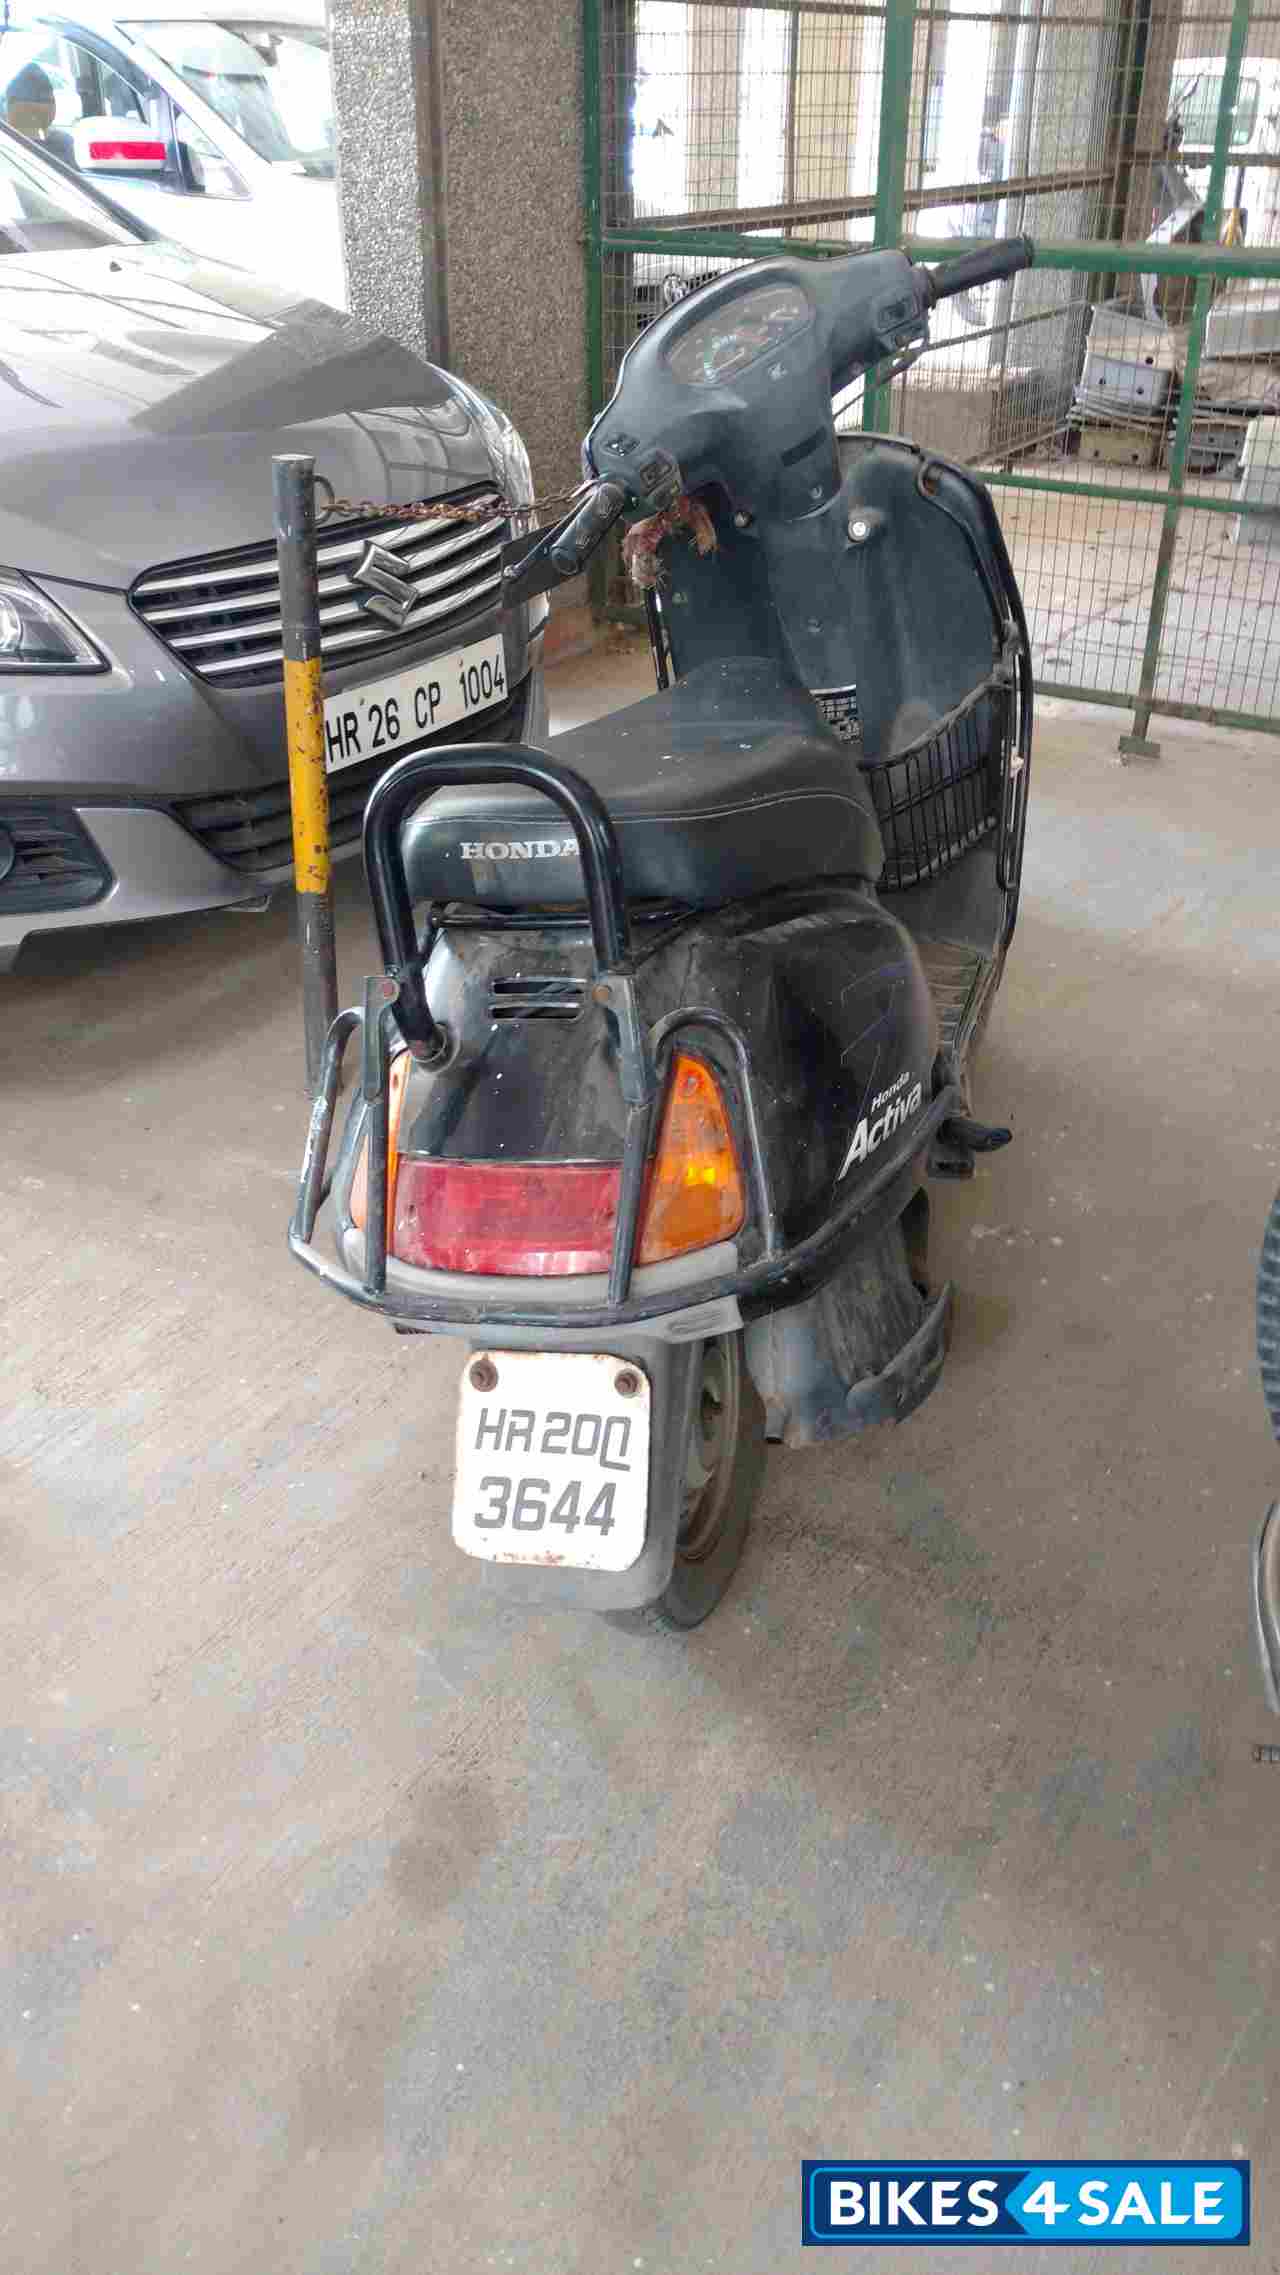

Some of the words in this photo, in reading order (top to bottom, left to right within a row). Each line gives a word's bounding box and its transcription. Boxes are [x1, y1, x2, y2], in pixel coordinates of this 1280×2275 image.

[326, 711, 361, 763] HR
[368, 697, 401, 748] 26
[414, 681, 441, 729] CP
[459, 654, 505, 709] 1004
[460, 838, 580, 860] HONDA
[838, 1081, 921, 1181] Activa
[474, 1475, 617, 1536] 3644
